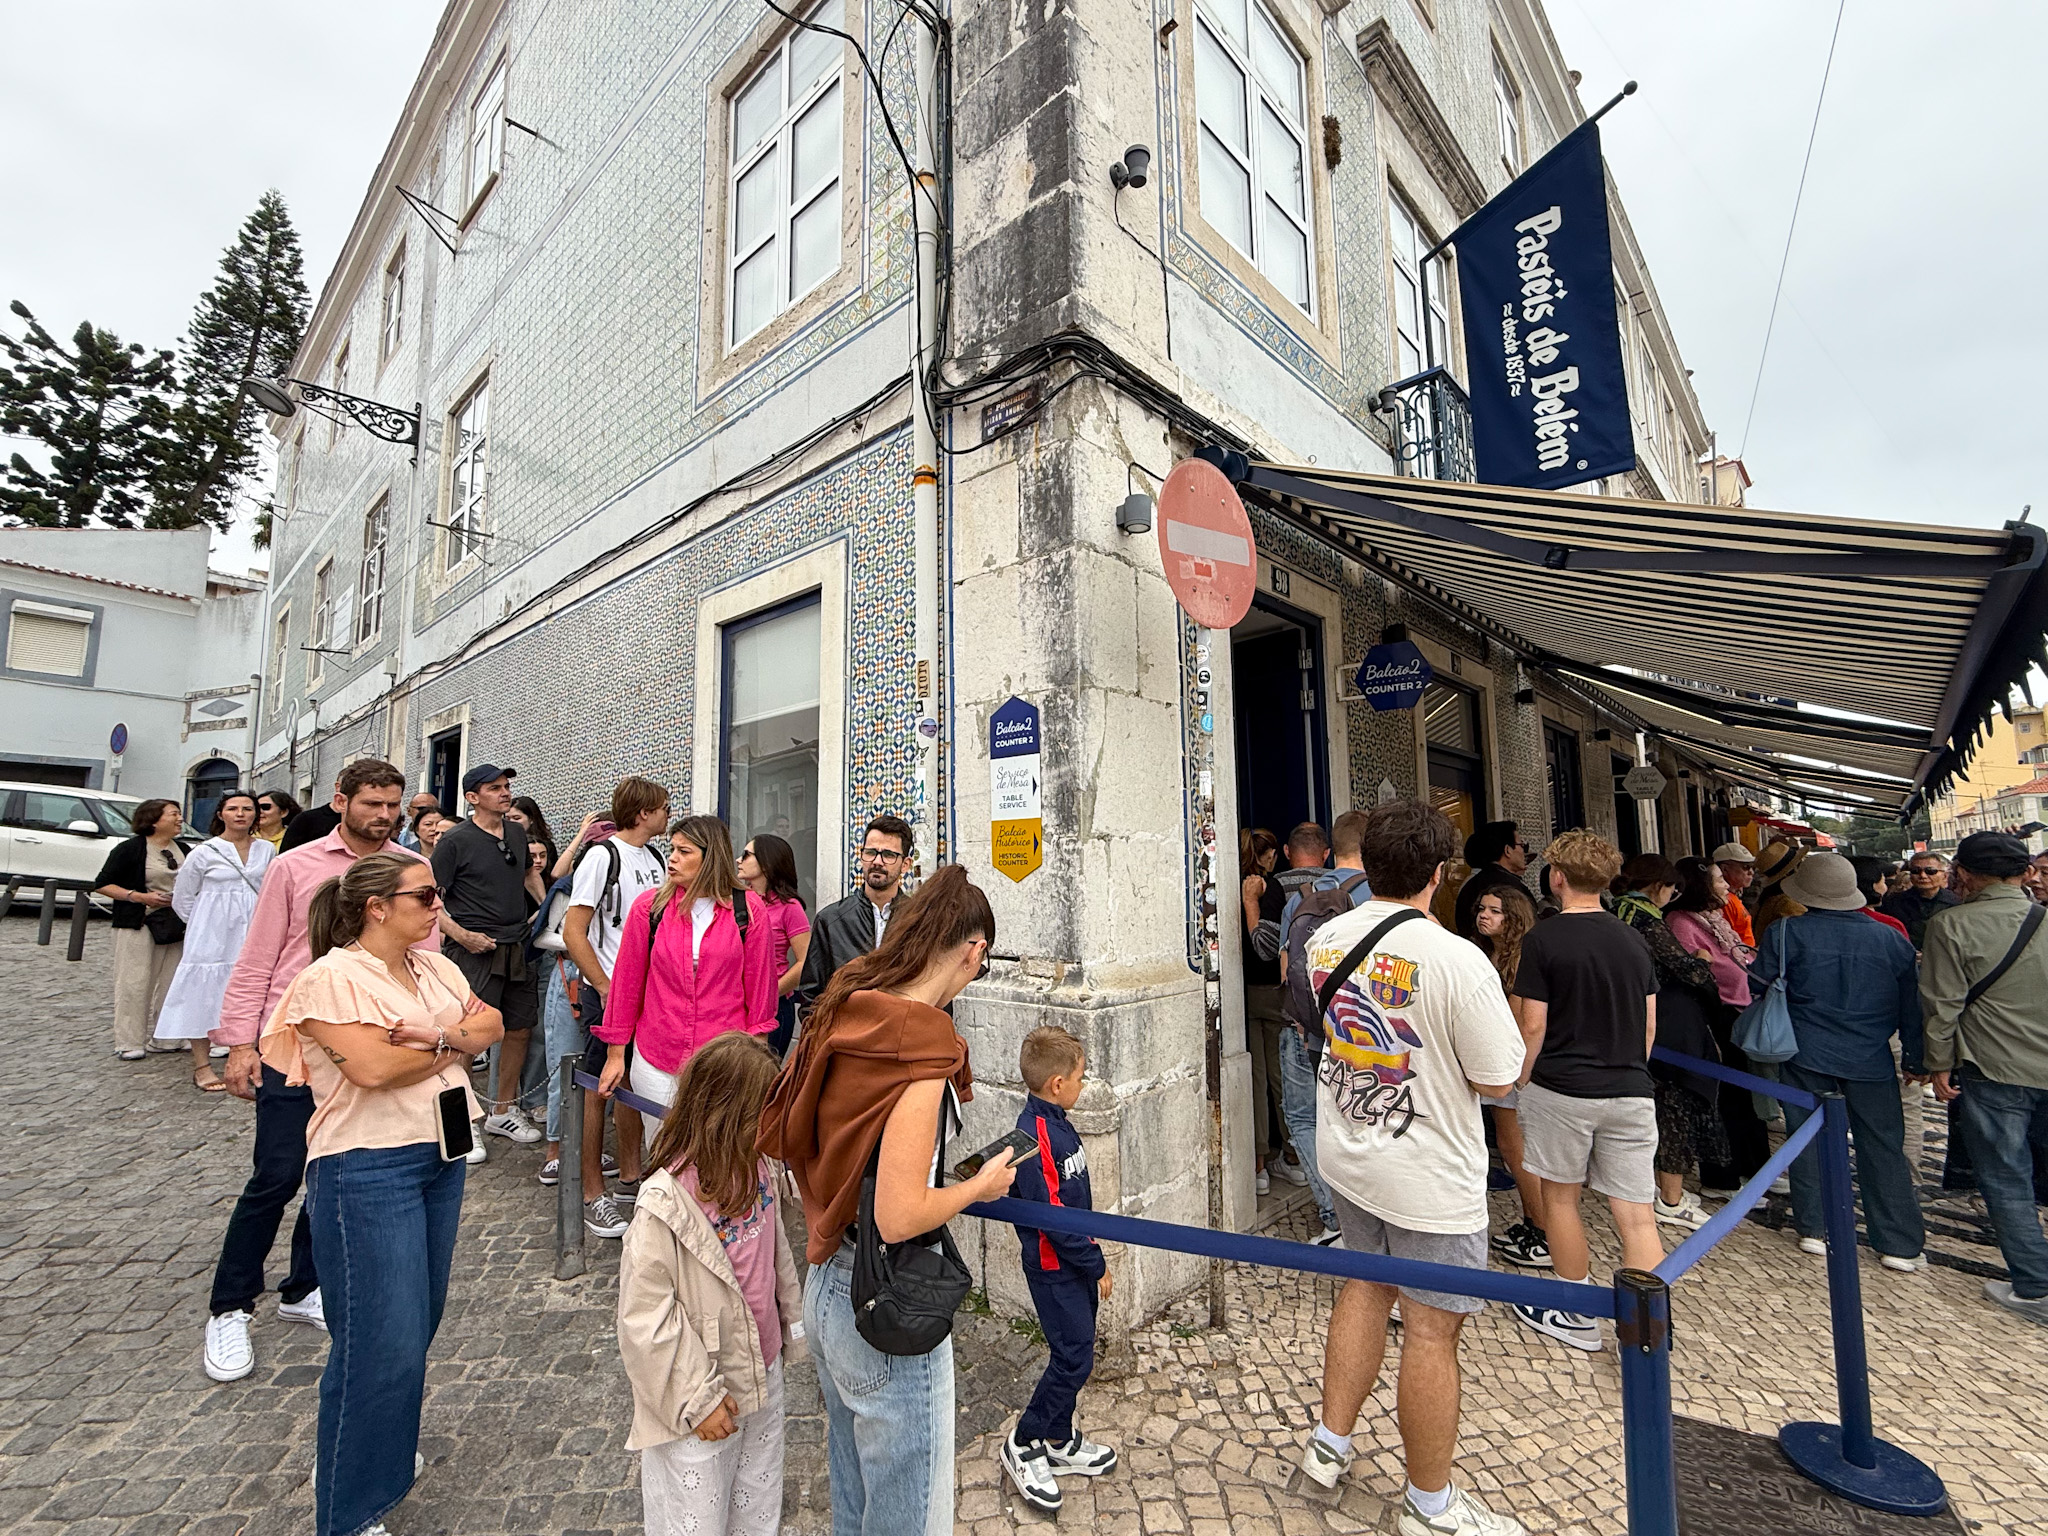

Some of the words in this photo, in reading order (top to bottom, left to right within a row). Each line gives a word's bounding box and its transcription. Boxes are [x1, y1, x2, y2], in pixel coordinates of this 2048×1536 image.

[1513, 205, 1568, 322] Pastéis
[1501, 317, 1520, 355] desde
[1525, 326, 1570, 367] de
[1505, 354, 1526, 385] 1837
[1530, 366, 1580, 471] Belém
[1275, 569, 1288, 594] 98
[1366, 662, 1410, 681] Balcão
[1409, 658, 1421, 675] 2
[1365, 682, 1414, 695] COUNTER
[1415, 680, 1423, 689] 2
[995, 720, 1025, 736] Balcão
[1024, 716, 1032, 731] 2
[995, 738, 1028, 748] COUNTER
[996, 766, 1029, 780] Serviço
[996, 776, 1007, 789] de
[1006, 776, 1029, 788] Mesa
[998, 801, 1028, 810] SERVICE
[1002, 794, 1023, 802] TABLE
[999, 825, 1026, 837] Balcão
[998, 852, 1028, 860] HISTORIC
[998, 859, 1029, 867] COUNTER
